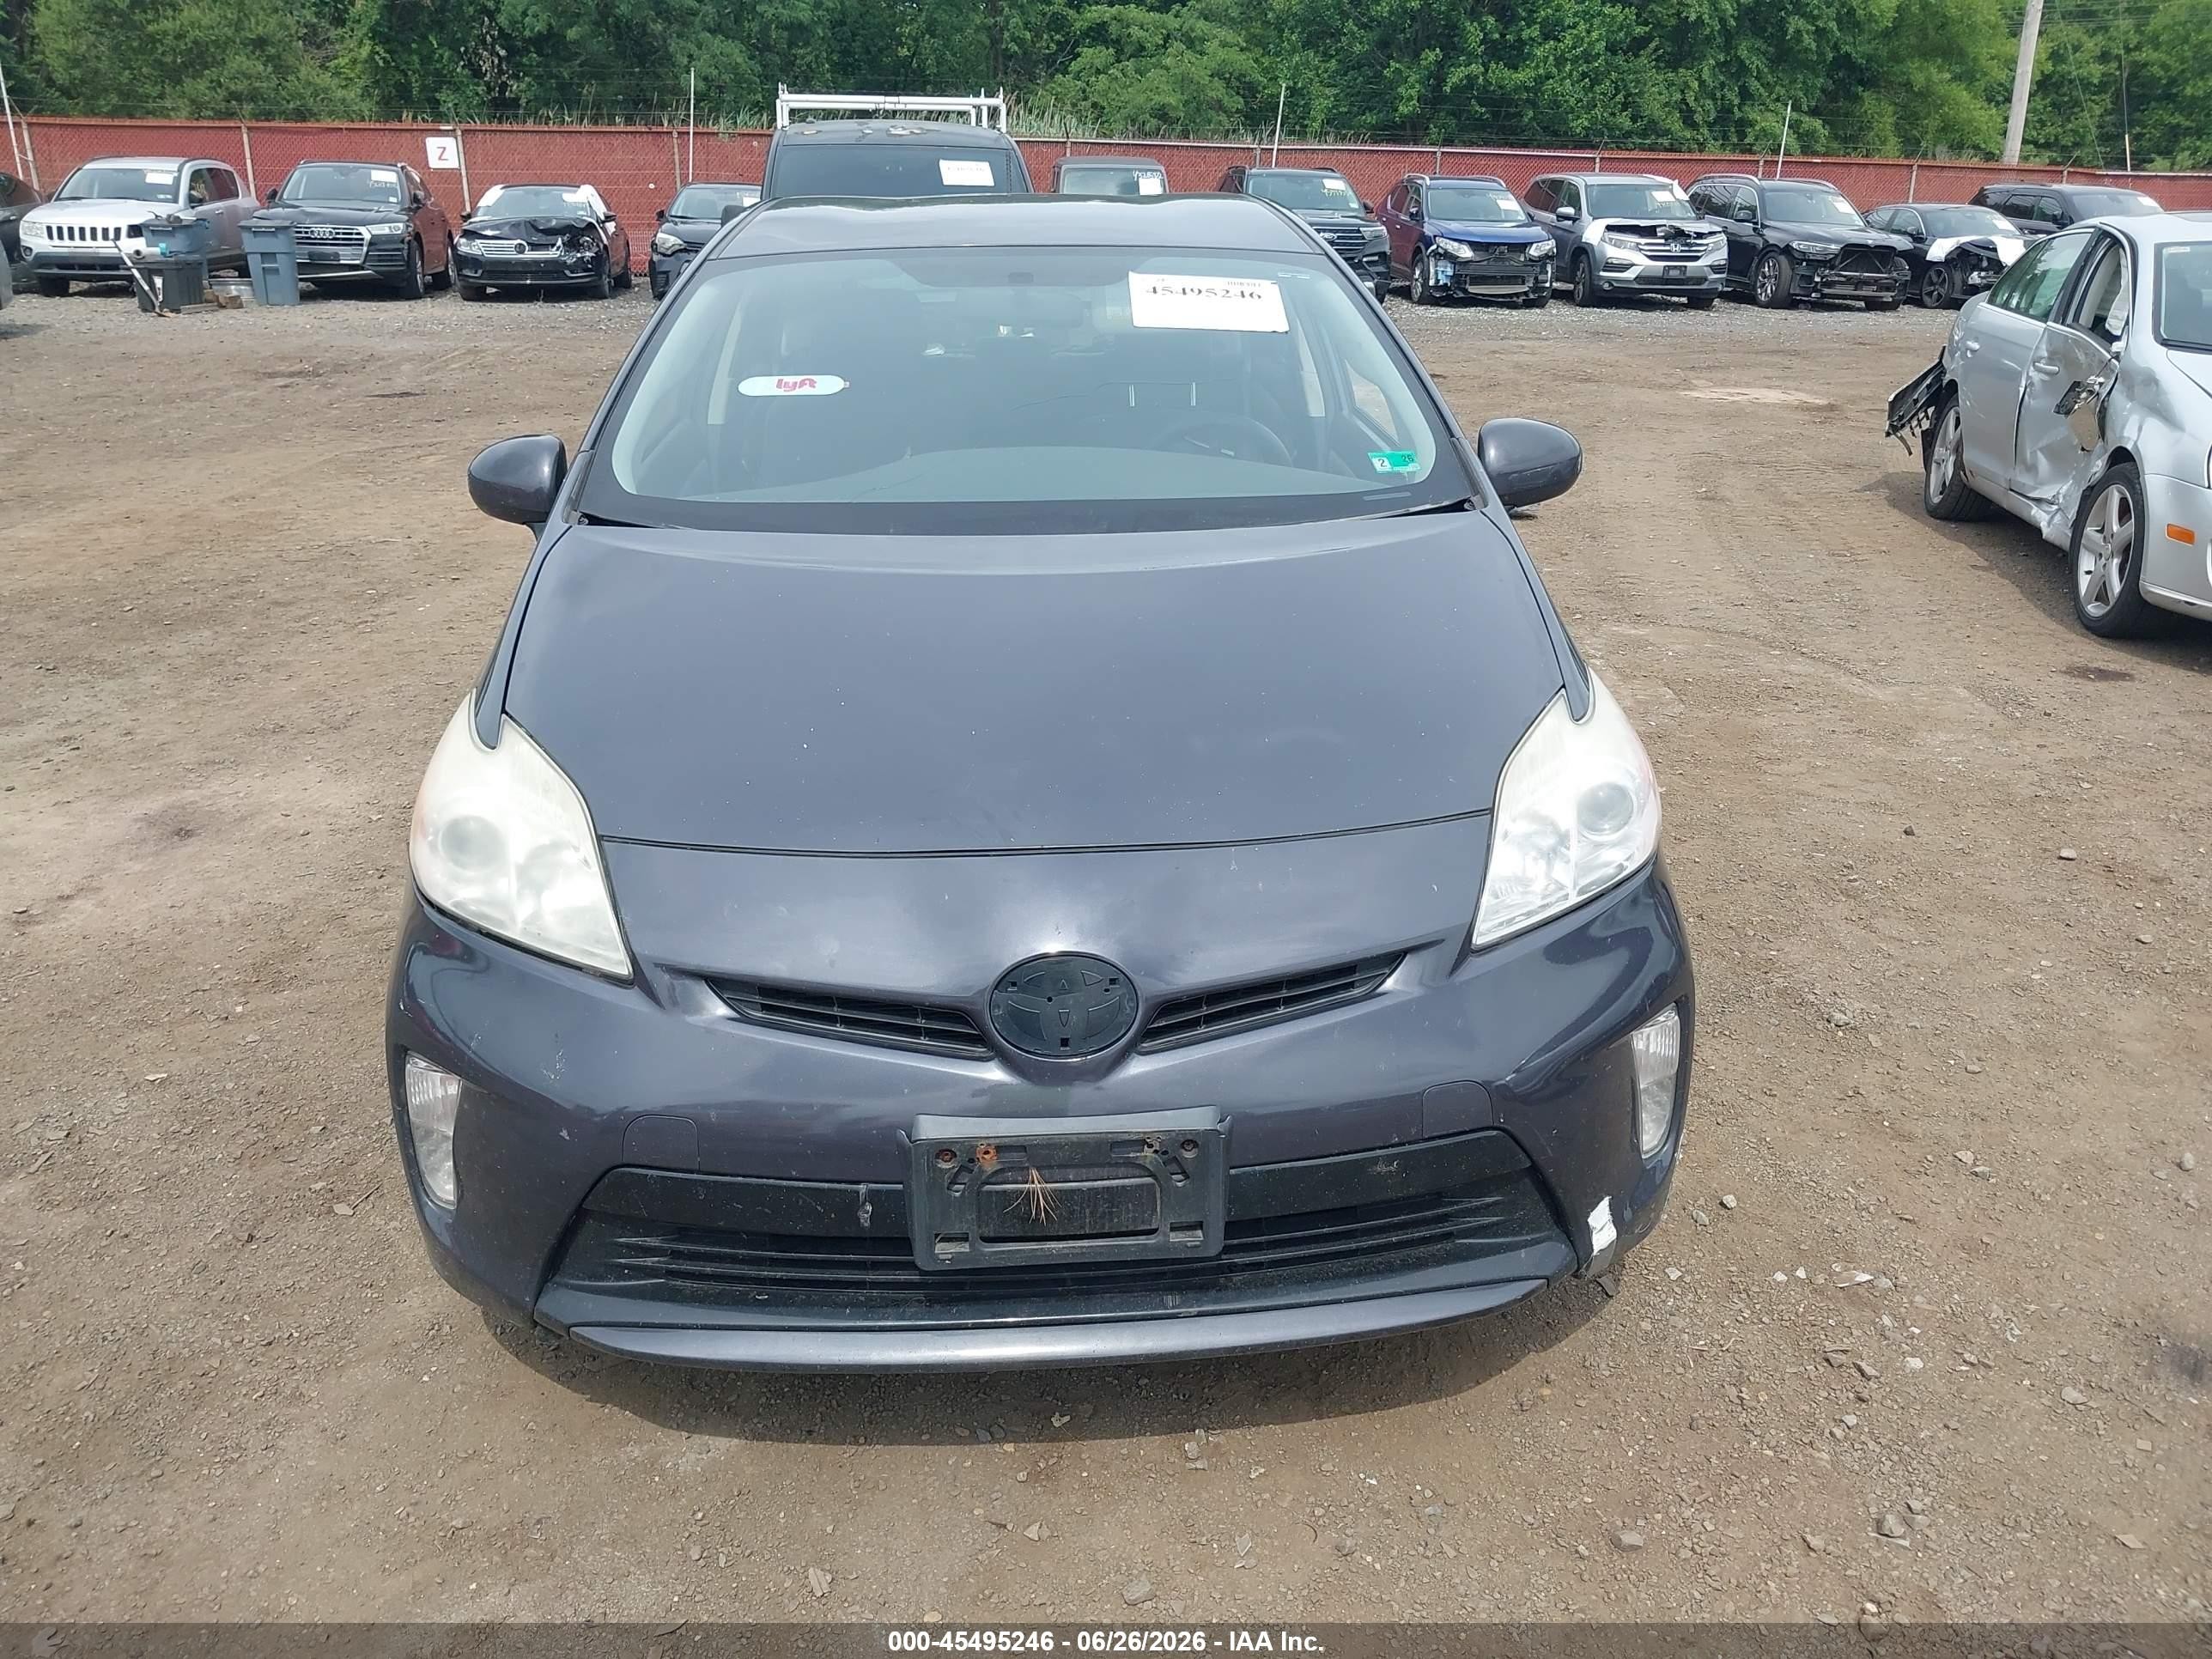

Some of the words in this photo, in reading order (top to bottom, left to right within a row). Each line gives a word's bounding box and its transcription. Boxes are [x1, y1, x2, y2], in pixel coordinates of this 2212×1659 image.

[436, 147, 449, 161] Z
[776, 378, 817, 392] lyft
[1377, 458, 1388, 467] 2
